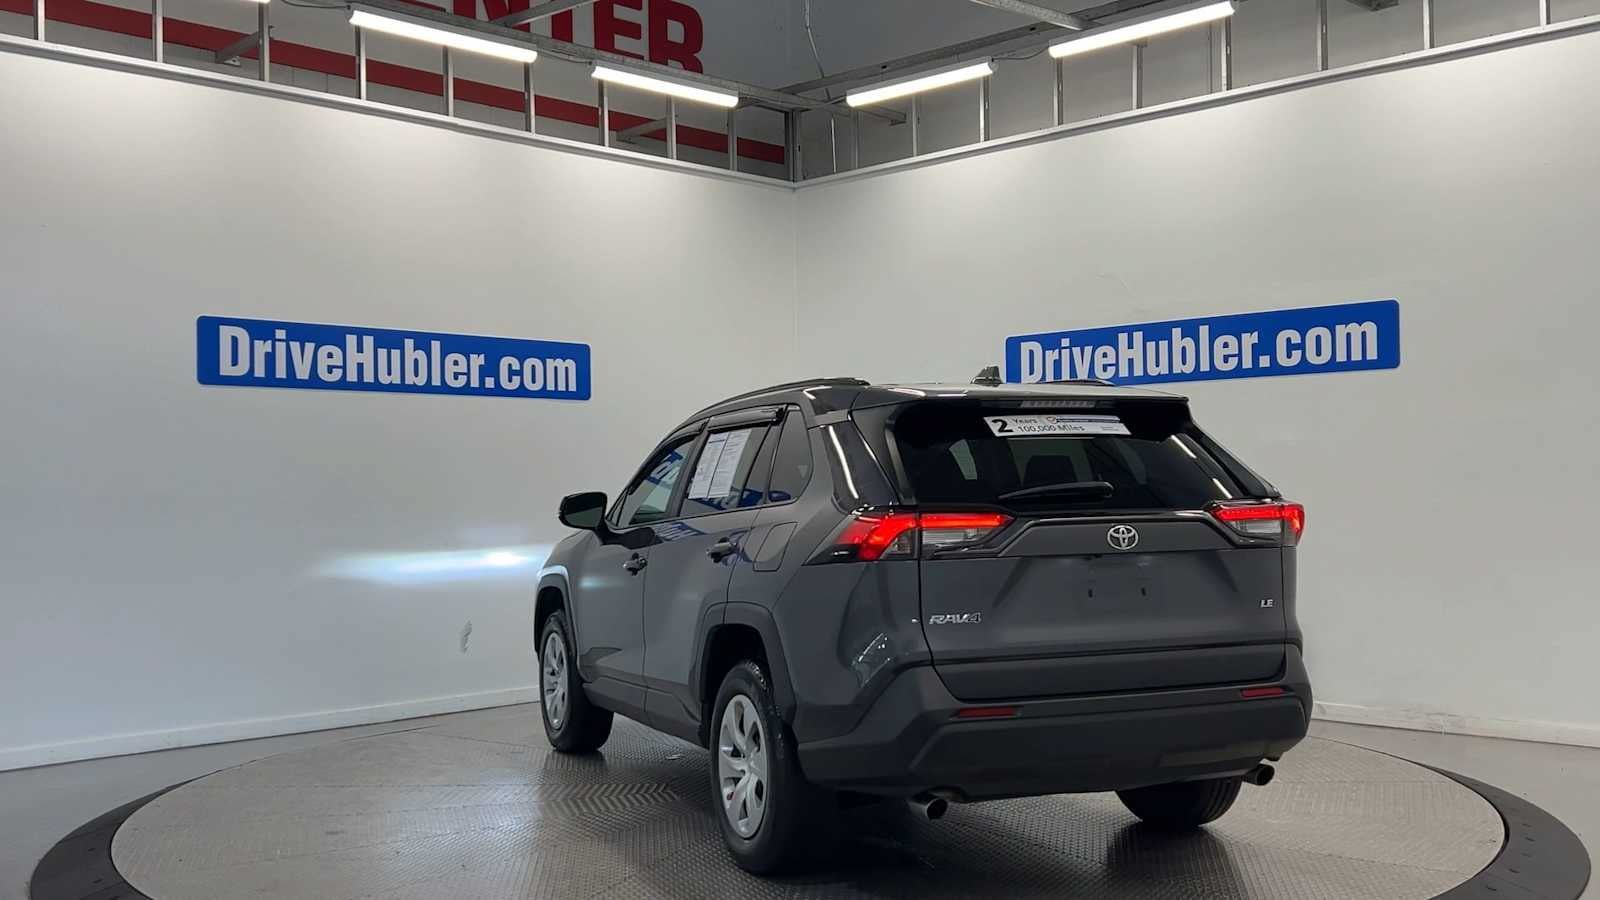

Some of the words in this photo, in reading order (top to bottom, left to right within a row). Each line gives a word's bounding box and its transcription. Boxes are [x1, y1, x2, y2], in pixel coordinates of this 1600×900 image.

[218, 324, 577, 392] DriveHubler.com
[1019, 320, 1379, 384] DriveHubler.com
[991, 418, 1014, 433] 2
[1260, 599, 1274, 608] LE
[928, 612, 982, 625] RAV4
